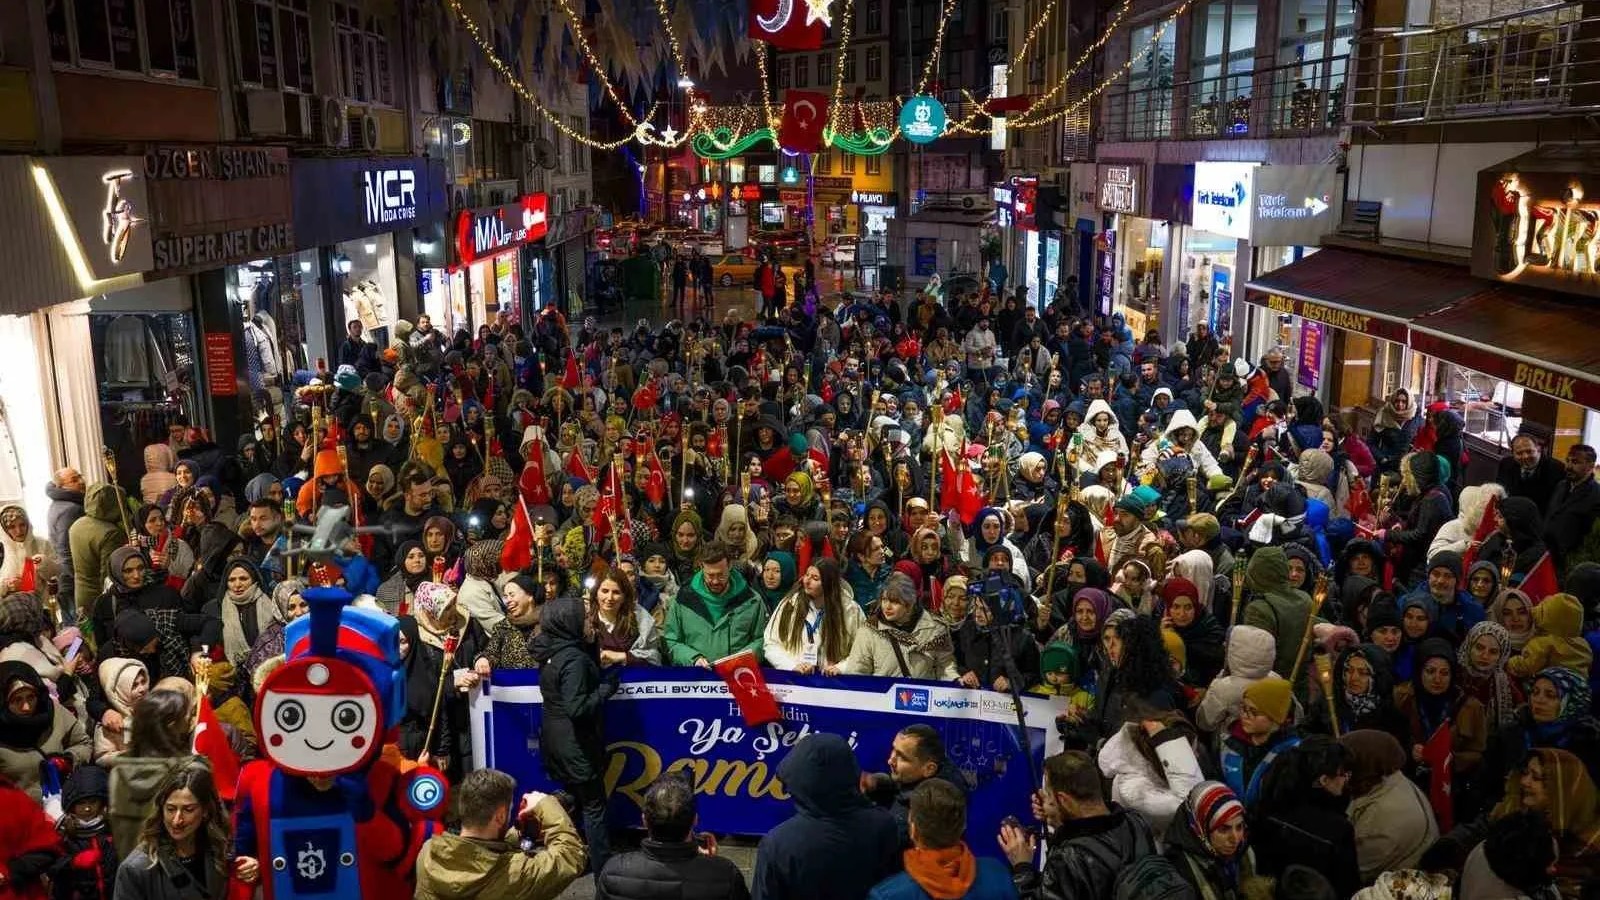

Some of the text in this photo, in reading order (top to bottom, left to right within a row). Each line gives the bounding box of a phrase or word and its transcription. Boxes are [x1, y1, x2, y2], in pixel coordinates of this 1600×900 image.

[364, 169, 416, 224] MCR
[257, 222, 294, 251] CAFE
[1302, 301, 1371, 333] RESTAURANT
[678, 718, 746, 755] Ya
